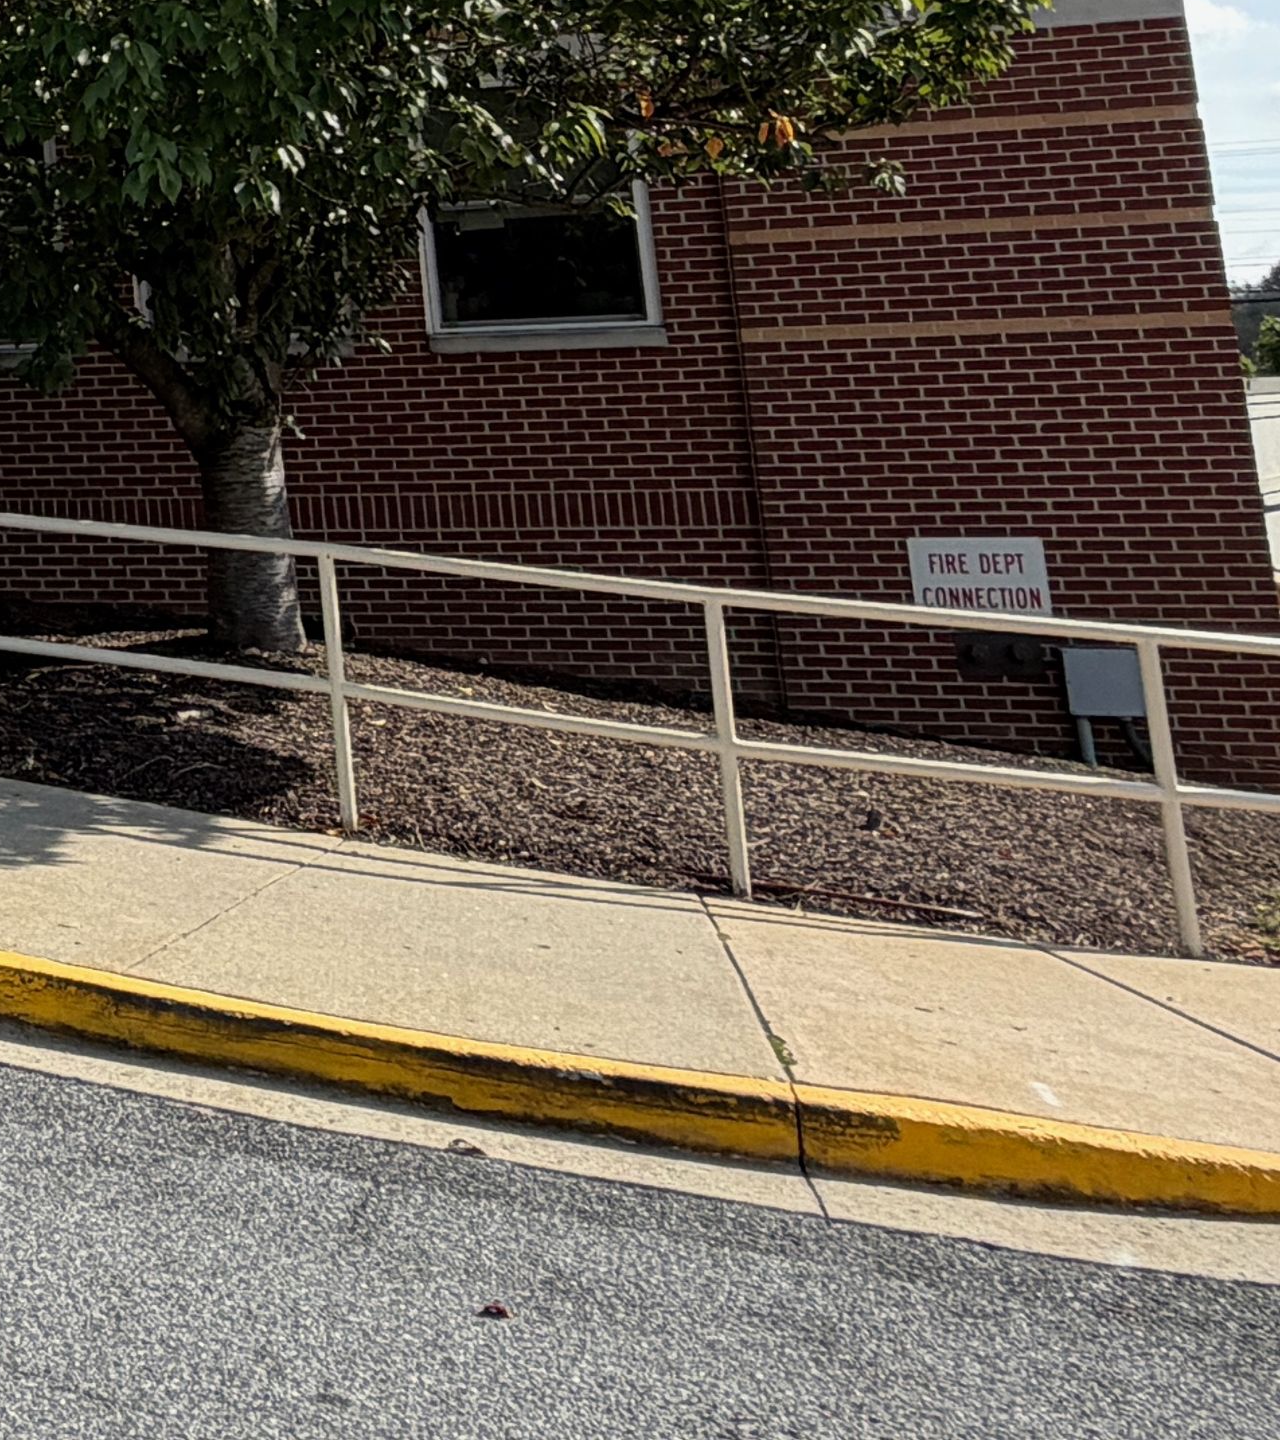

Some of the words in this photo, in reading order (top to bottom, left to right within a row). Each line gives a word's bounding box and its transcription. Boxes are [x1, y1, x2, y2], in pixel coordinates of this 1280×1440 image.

[928, 553, 970, 575] FIRE
[979, 553, 1025, 575] DEPT
[922, 587, 1043, 610] CONNECTION
